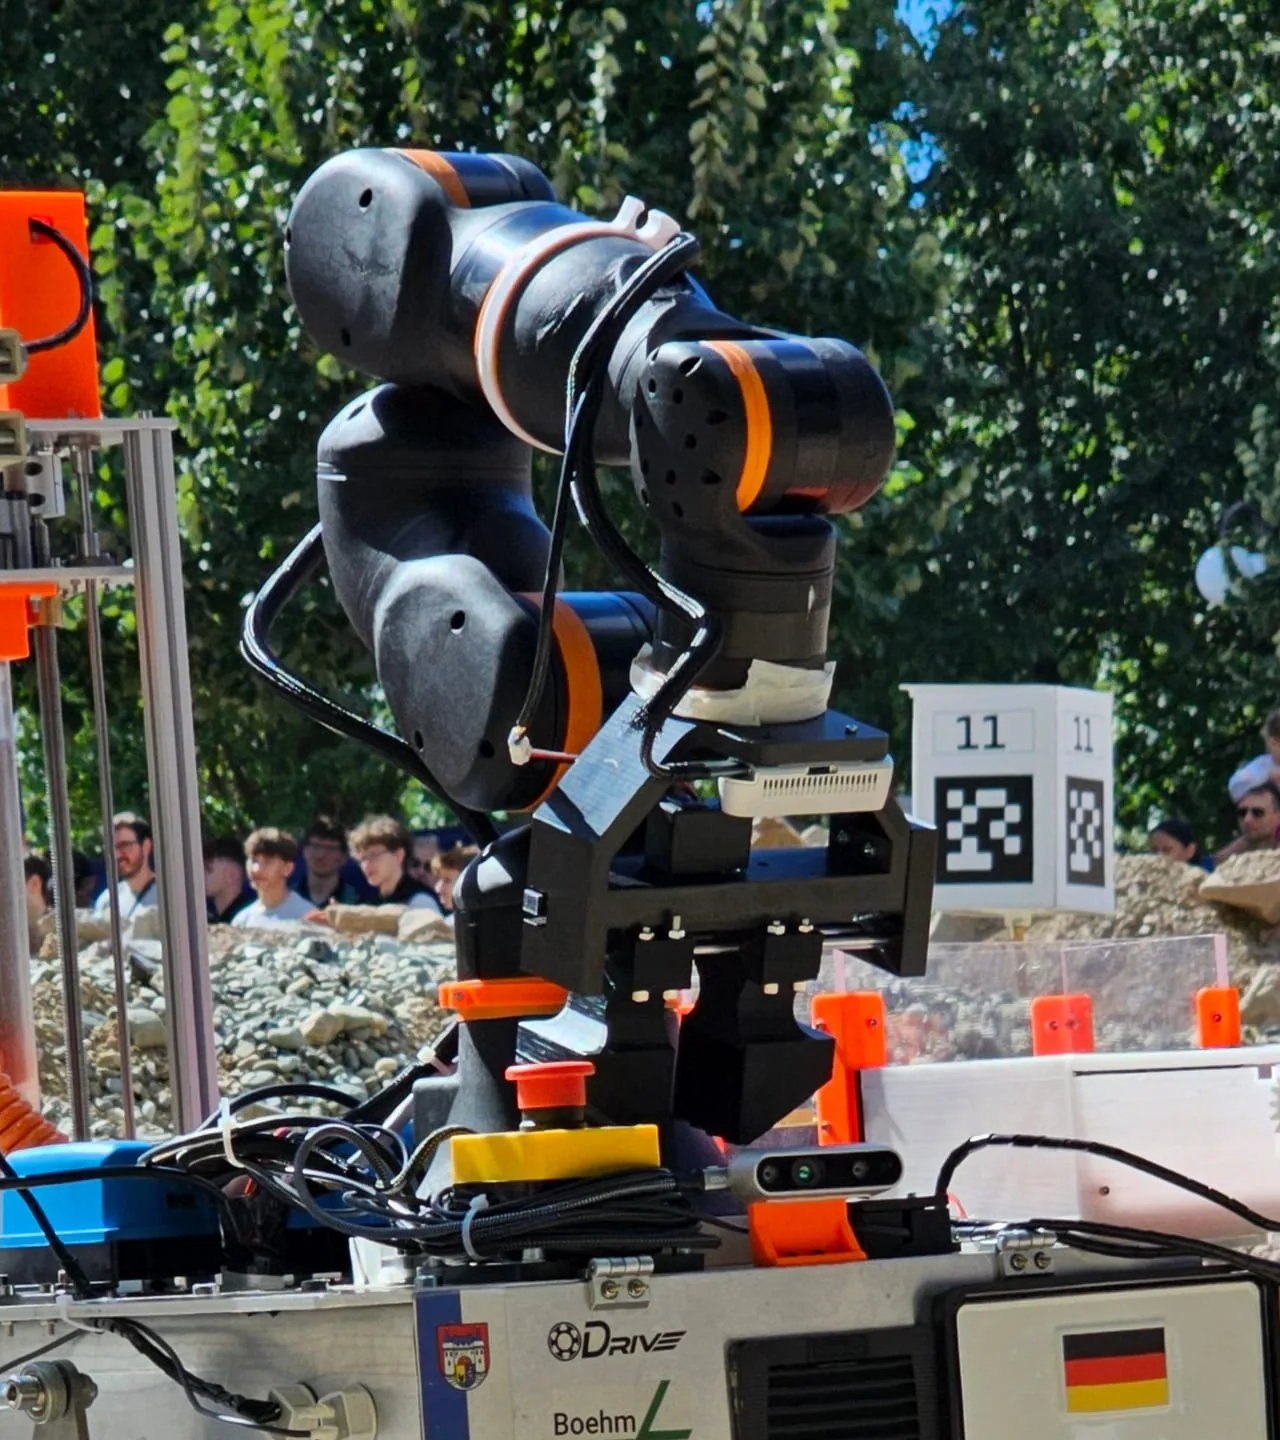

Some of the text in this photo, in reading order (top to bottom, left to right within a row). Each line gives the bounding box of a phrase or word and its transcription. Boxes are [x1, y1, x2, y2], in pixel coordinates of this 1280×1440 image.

[956, 714, 1006, 751] 11
[1072, 716, 1094, 753] 11
[553, 1408, 636, 1436] Boehm
